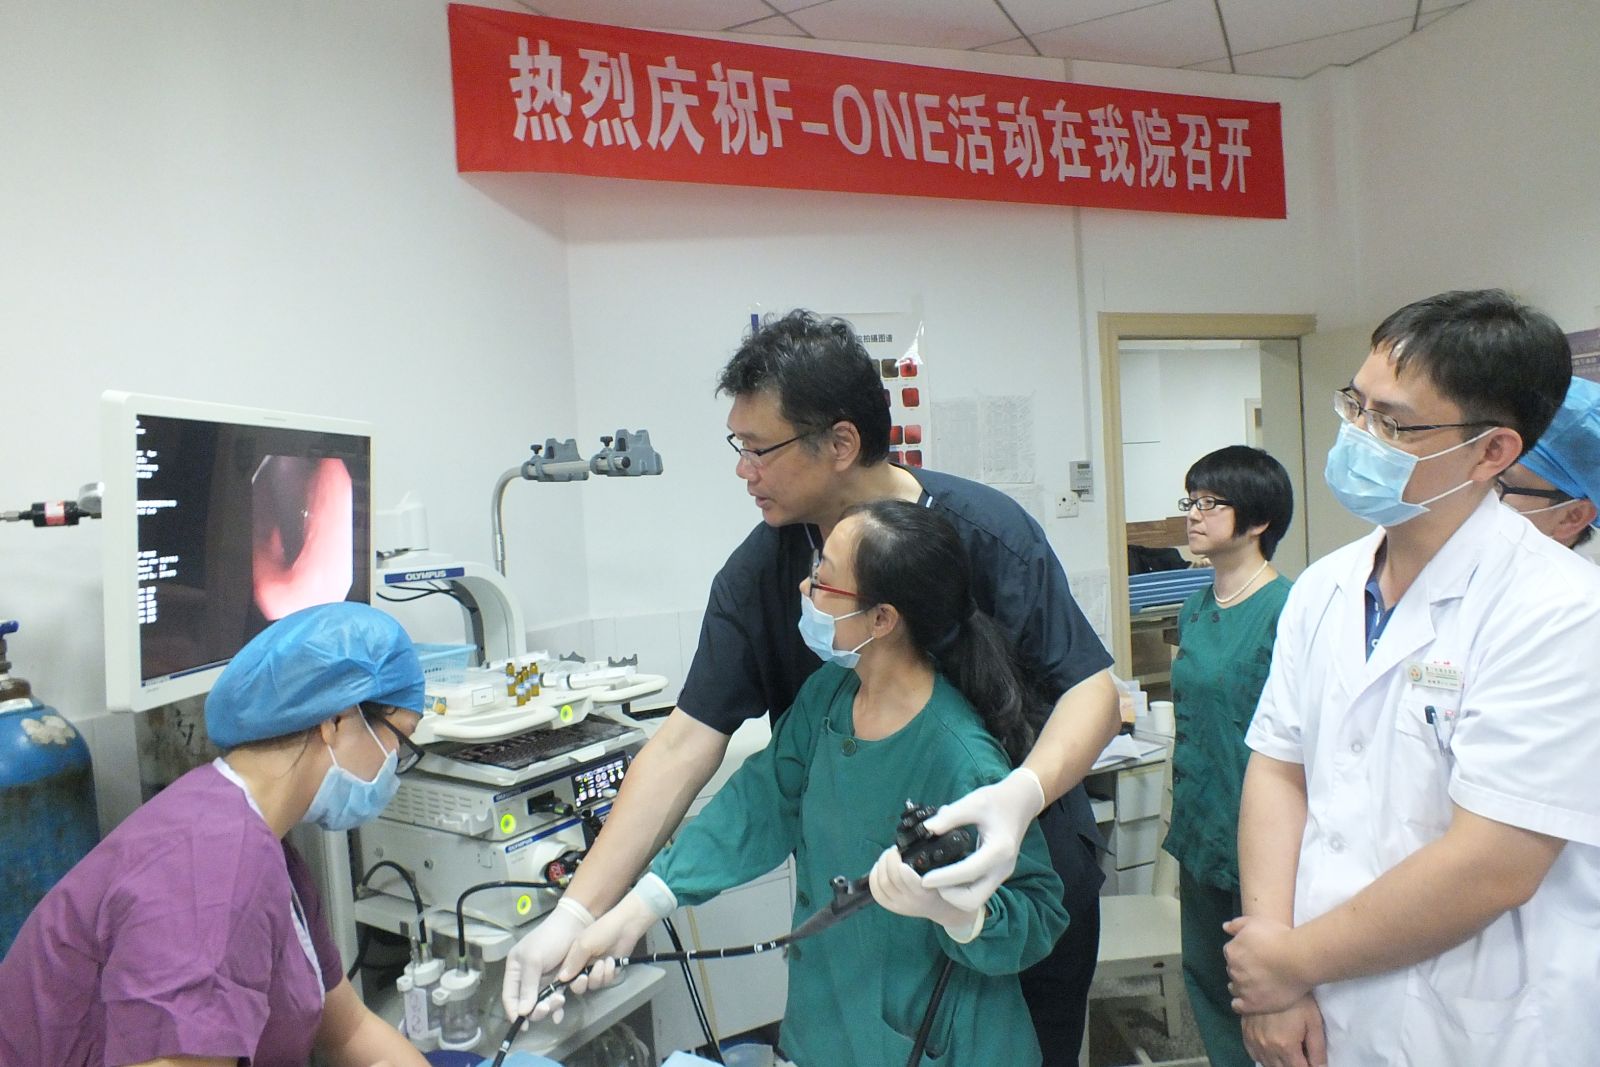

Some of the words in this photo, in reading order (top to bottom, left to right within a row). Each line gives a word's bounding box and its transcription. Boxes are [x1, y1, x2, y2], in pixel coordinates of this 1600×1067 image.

[509, 36, 1251, 193] 热烈庆祝F-ONE活动在我院召开
[404, 570, 447, 581] OLYMPUS
